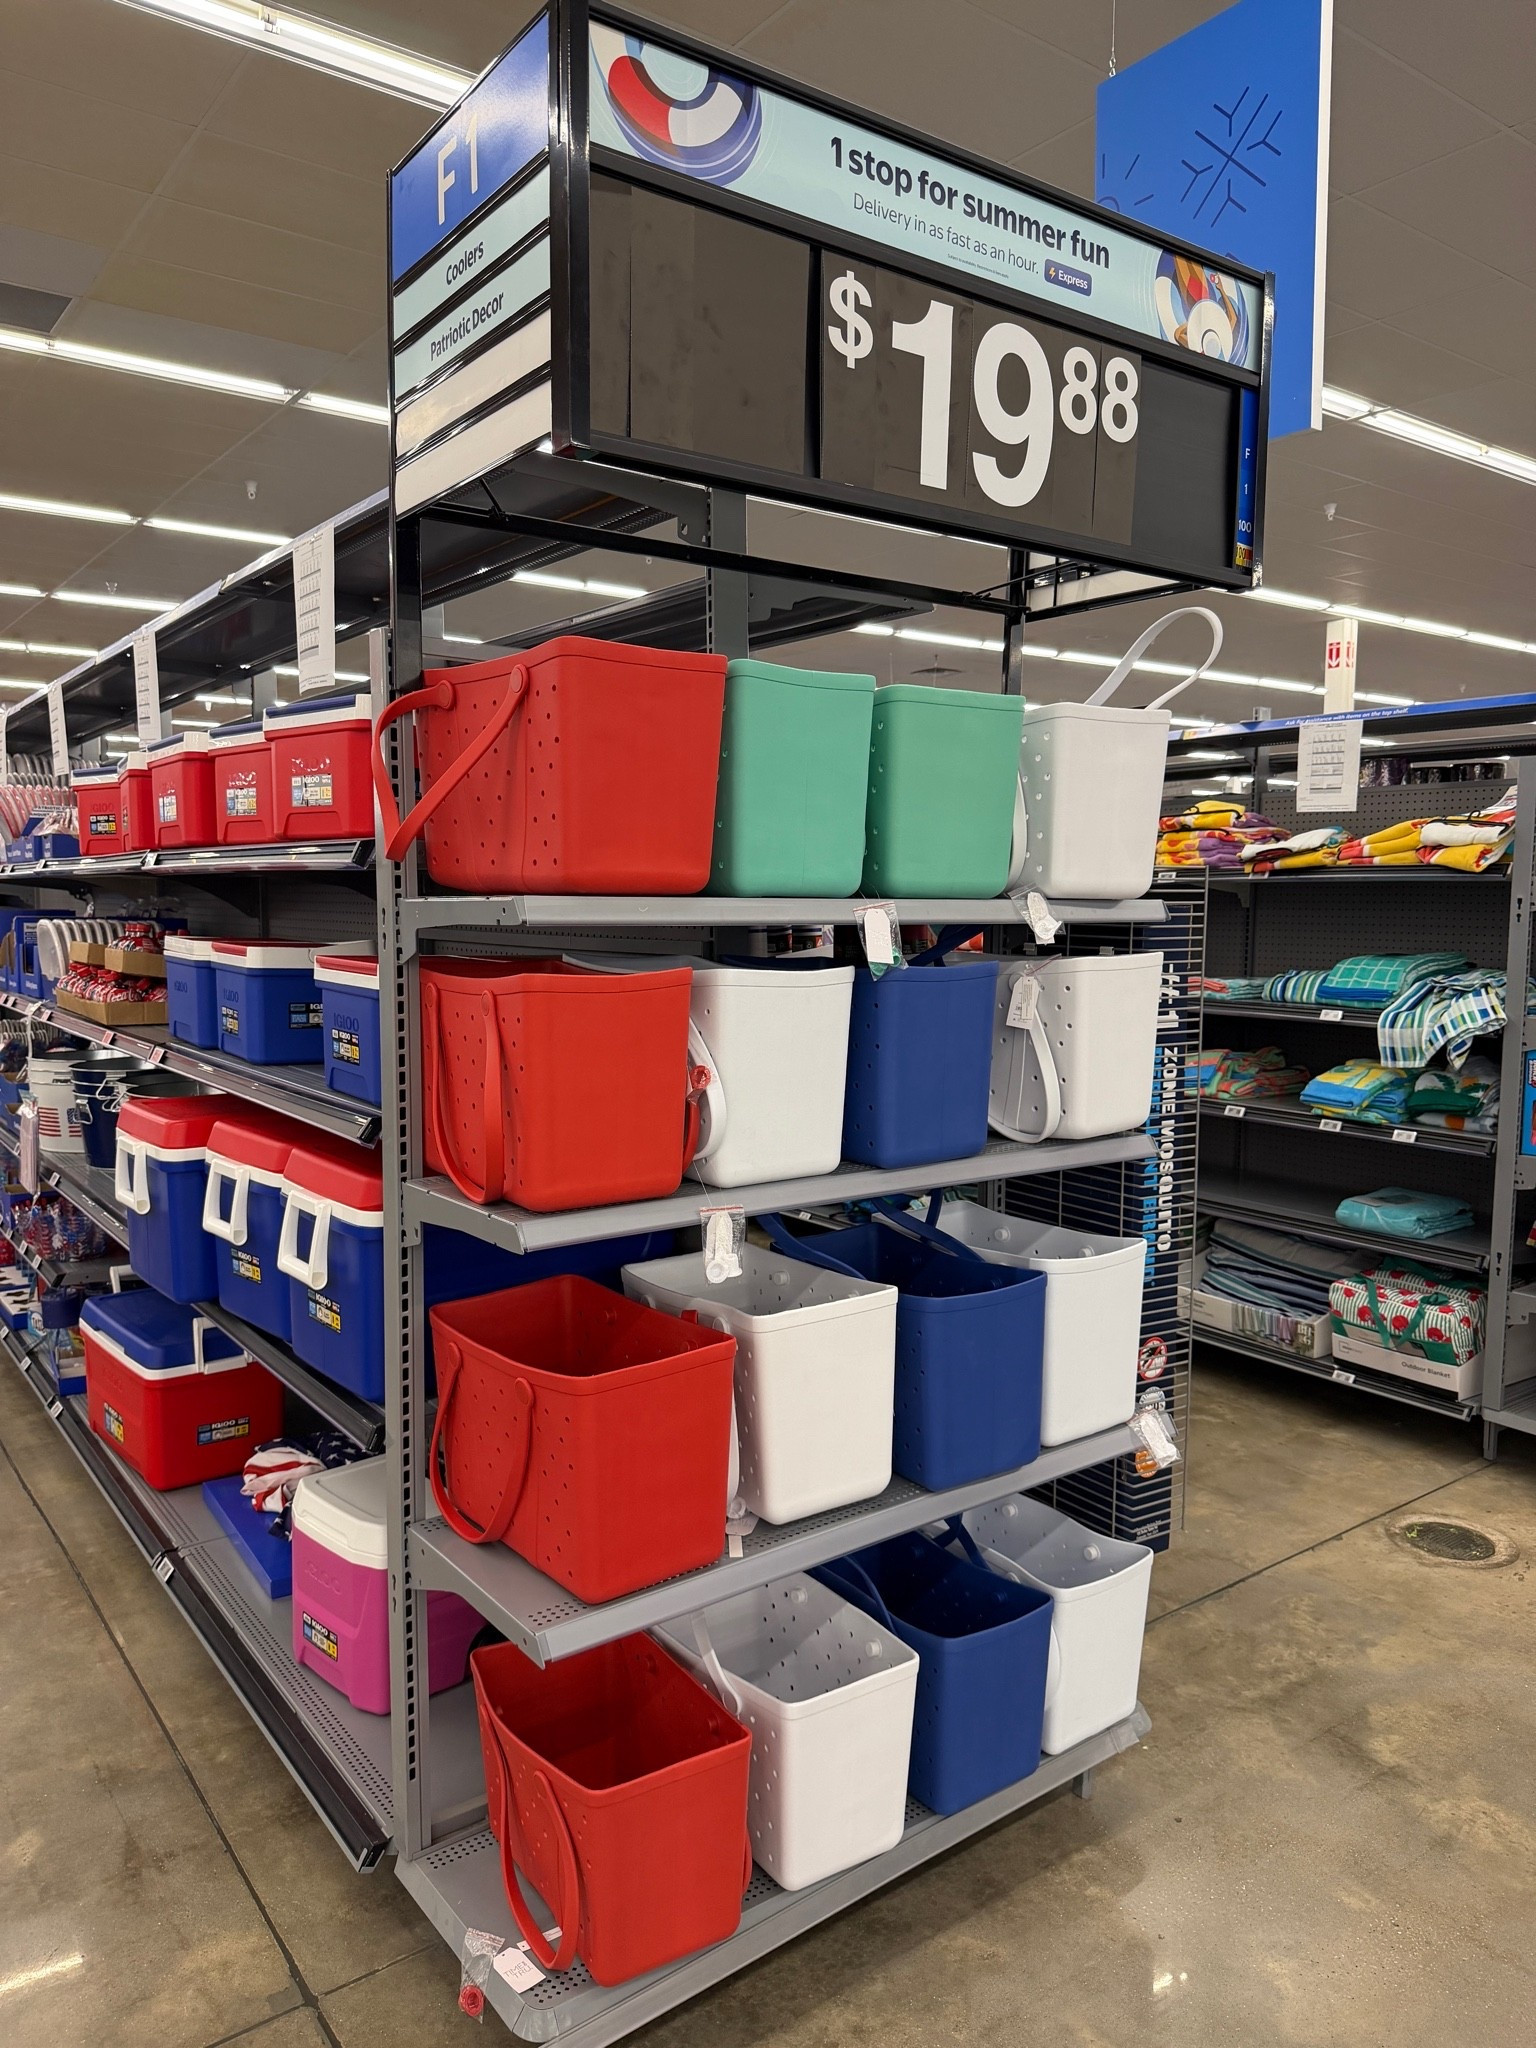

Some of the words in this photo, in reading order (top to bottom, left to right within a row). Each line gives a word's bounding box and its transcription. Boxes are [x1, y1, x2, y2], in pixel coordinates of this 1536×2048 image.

[438, 112, 478, 225] F1
[831, 136, 842, 169] 1
[848, 148, 913, 198] stop
[917, 170, 958, 211] for
[963, 192, 1067, 252] summer
[1070, 229, 1110, 269] fun
[854, 192, 912, 232] Delivery
[914, 214, 927, 233] in
[929, 223, 944, 240] as
[946, 226, 971, 250] fast
[973, 239, 988, 256] as
[990, 246, 1006, 263] an
[1008, 249, 1040, 275] hour.
[446, 242, 484, 285] Coolers
[1058, 270, 1088, 290] Express
[430, 317, 471, 361] Patriotic
[472, 292, 504, 331] Decor
[1245, 447, 1251, 459] F
[1238, 519, 1252, 533] 100
[1333, 713, 1346, 721] with
[1346, 712, 1361, 720] items
[1370, 709, 1381, 717] the
[1381, 709, 1393, 718] top
[333, 1012, 360, 1032] IGLOO
[1162, 1046, 1178, 1114] ZONE
[1157, 1119, 1175, 1252] MOSQUITO
[1401, 1361, 1427, 1372] Outdoor
[1427, 1367, 1451, 1379] Blanket
[211, 1419, 236, 1430] IGLOO
[312, 1619, 328, 1637] IGLOO
